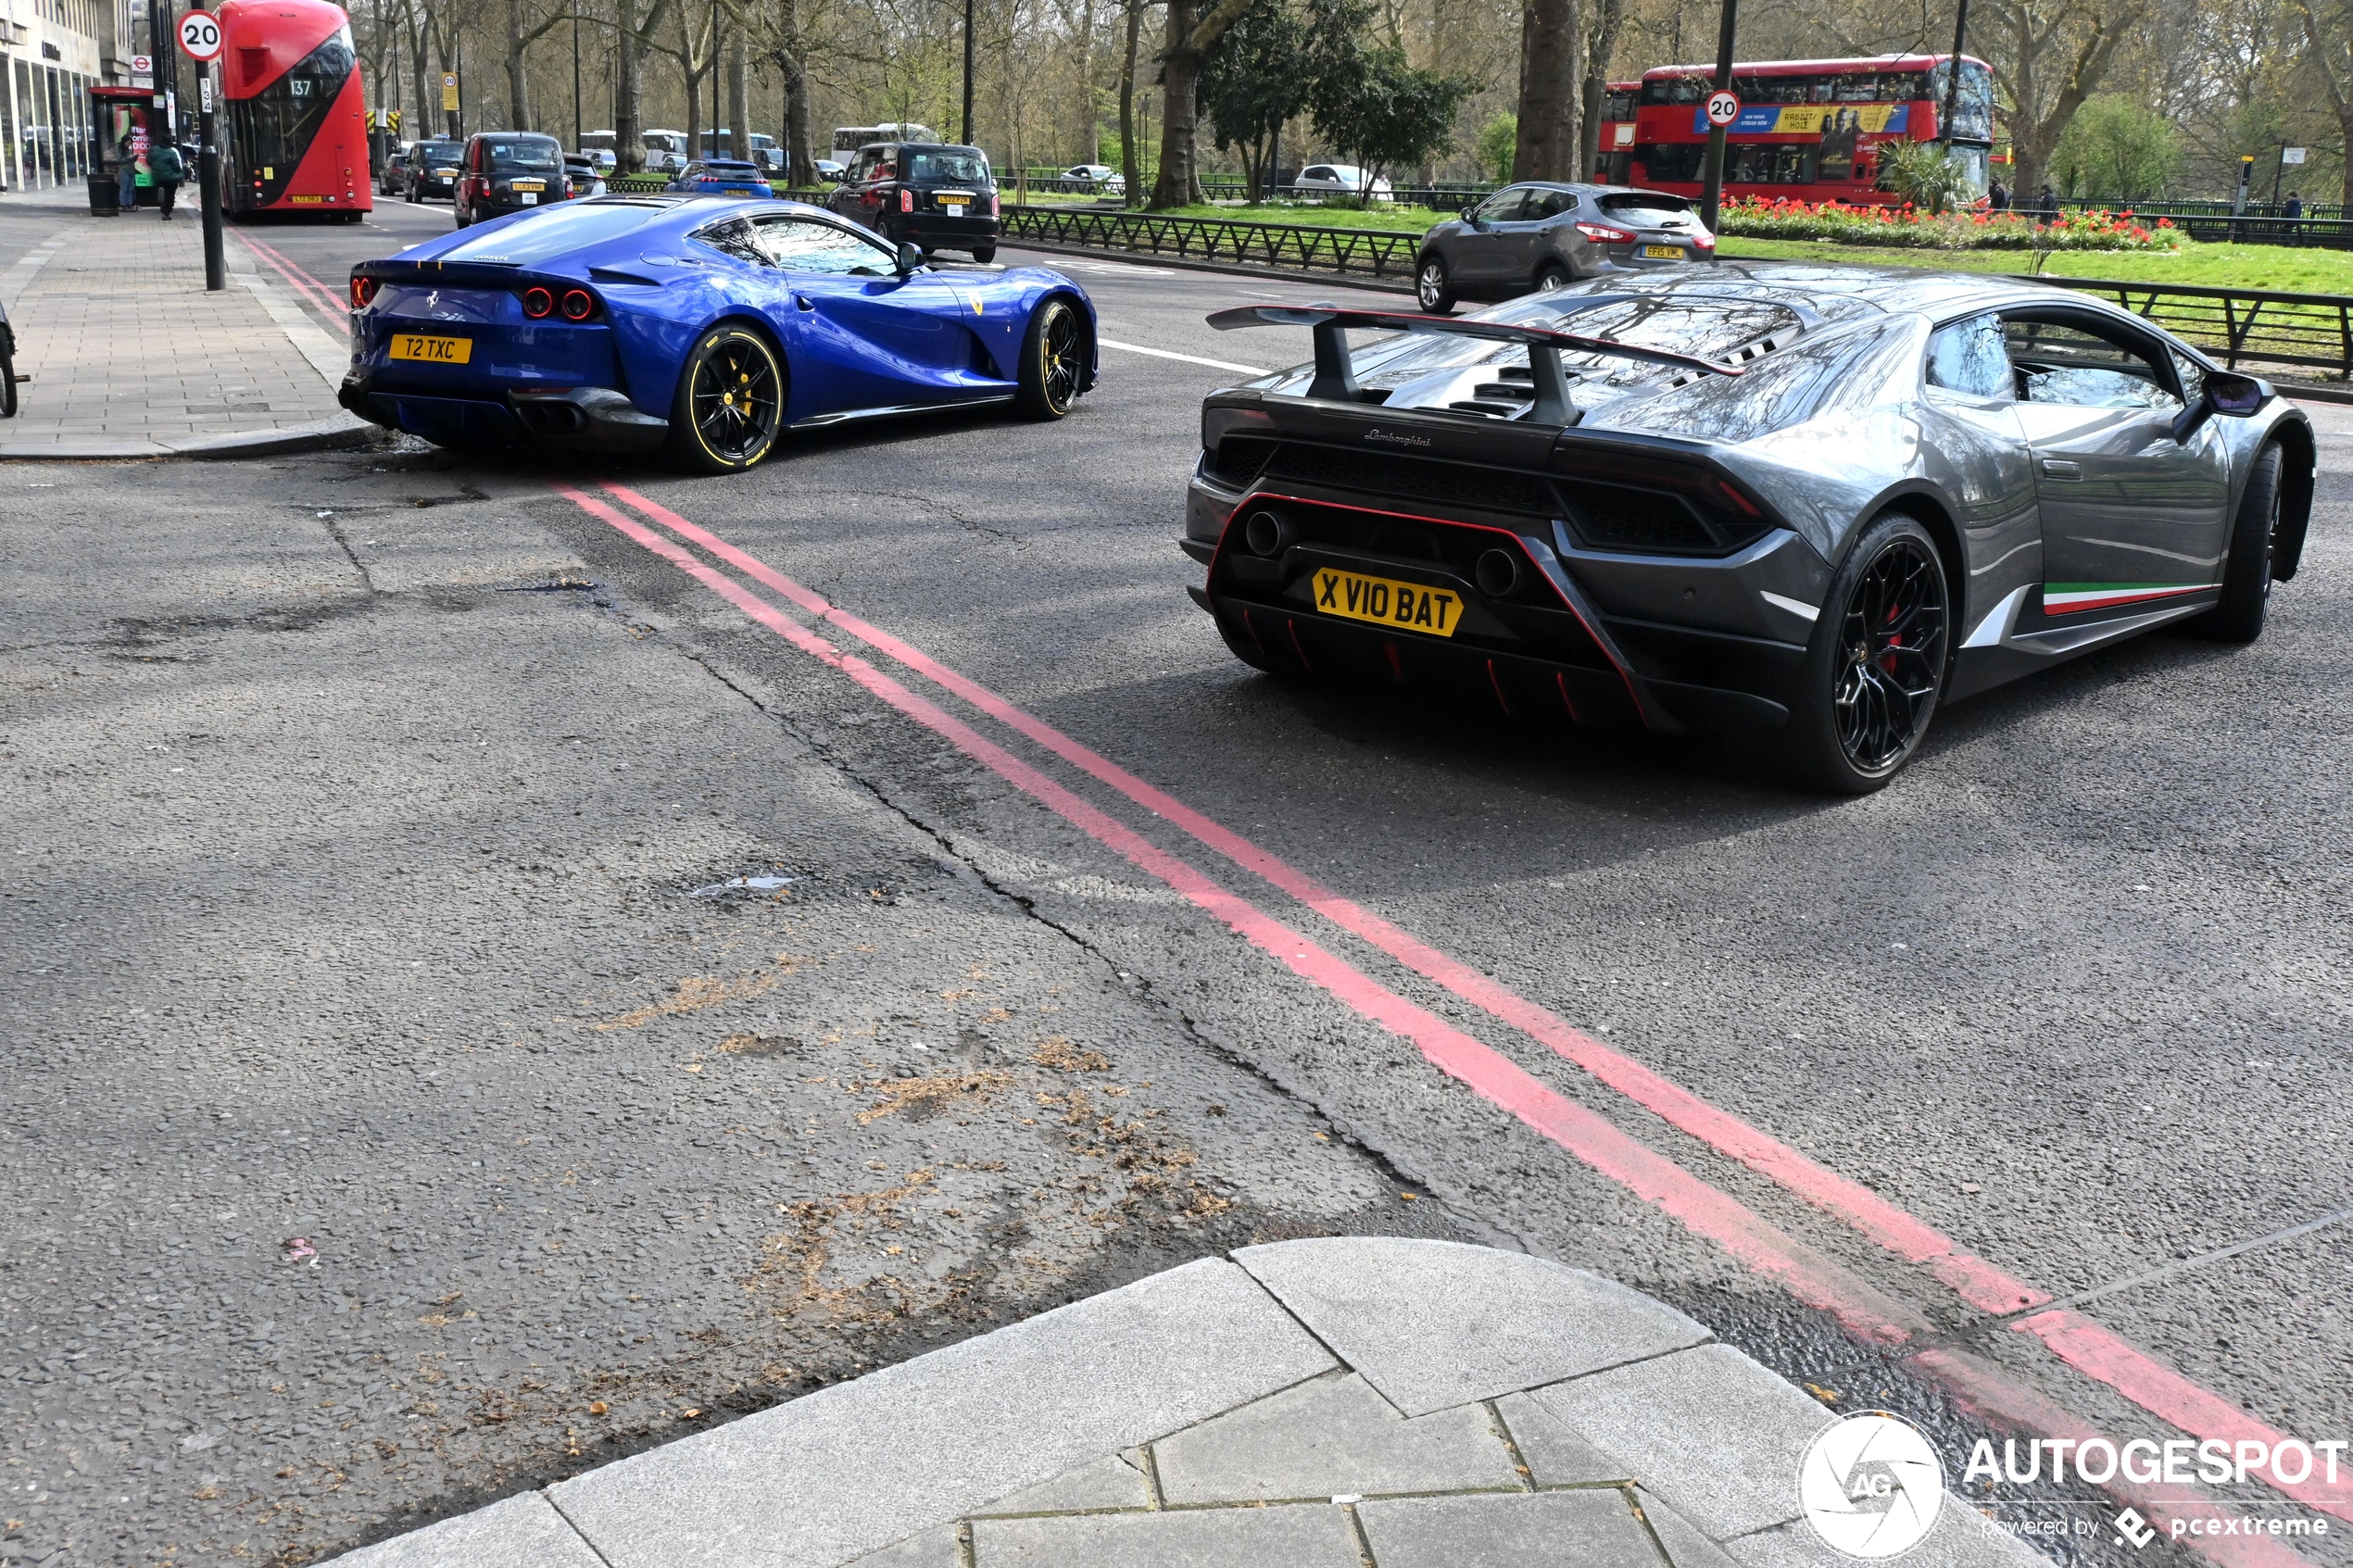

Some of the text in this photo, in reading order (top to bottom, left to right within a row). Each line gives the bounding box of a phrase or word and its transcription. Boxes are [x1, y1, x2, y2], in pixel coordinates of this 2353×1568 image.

[184, 24, 219, 45] 20
[291, 81, 311, 95] 137
[1711, 100, 1736, 117] 20
[1790, 121, 1809, 130] HOLE
[1647, 246, 1665, 257] EF15
[406, 338, 456, 359] T2 TXC
[1364, 429, 1431, 446] Lamborghini
[1395, 587, 1453, 630] BAT
